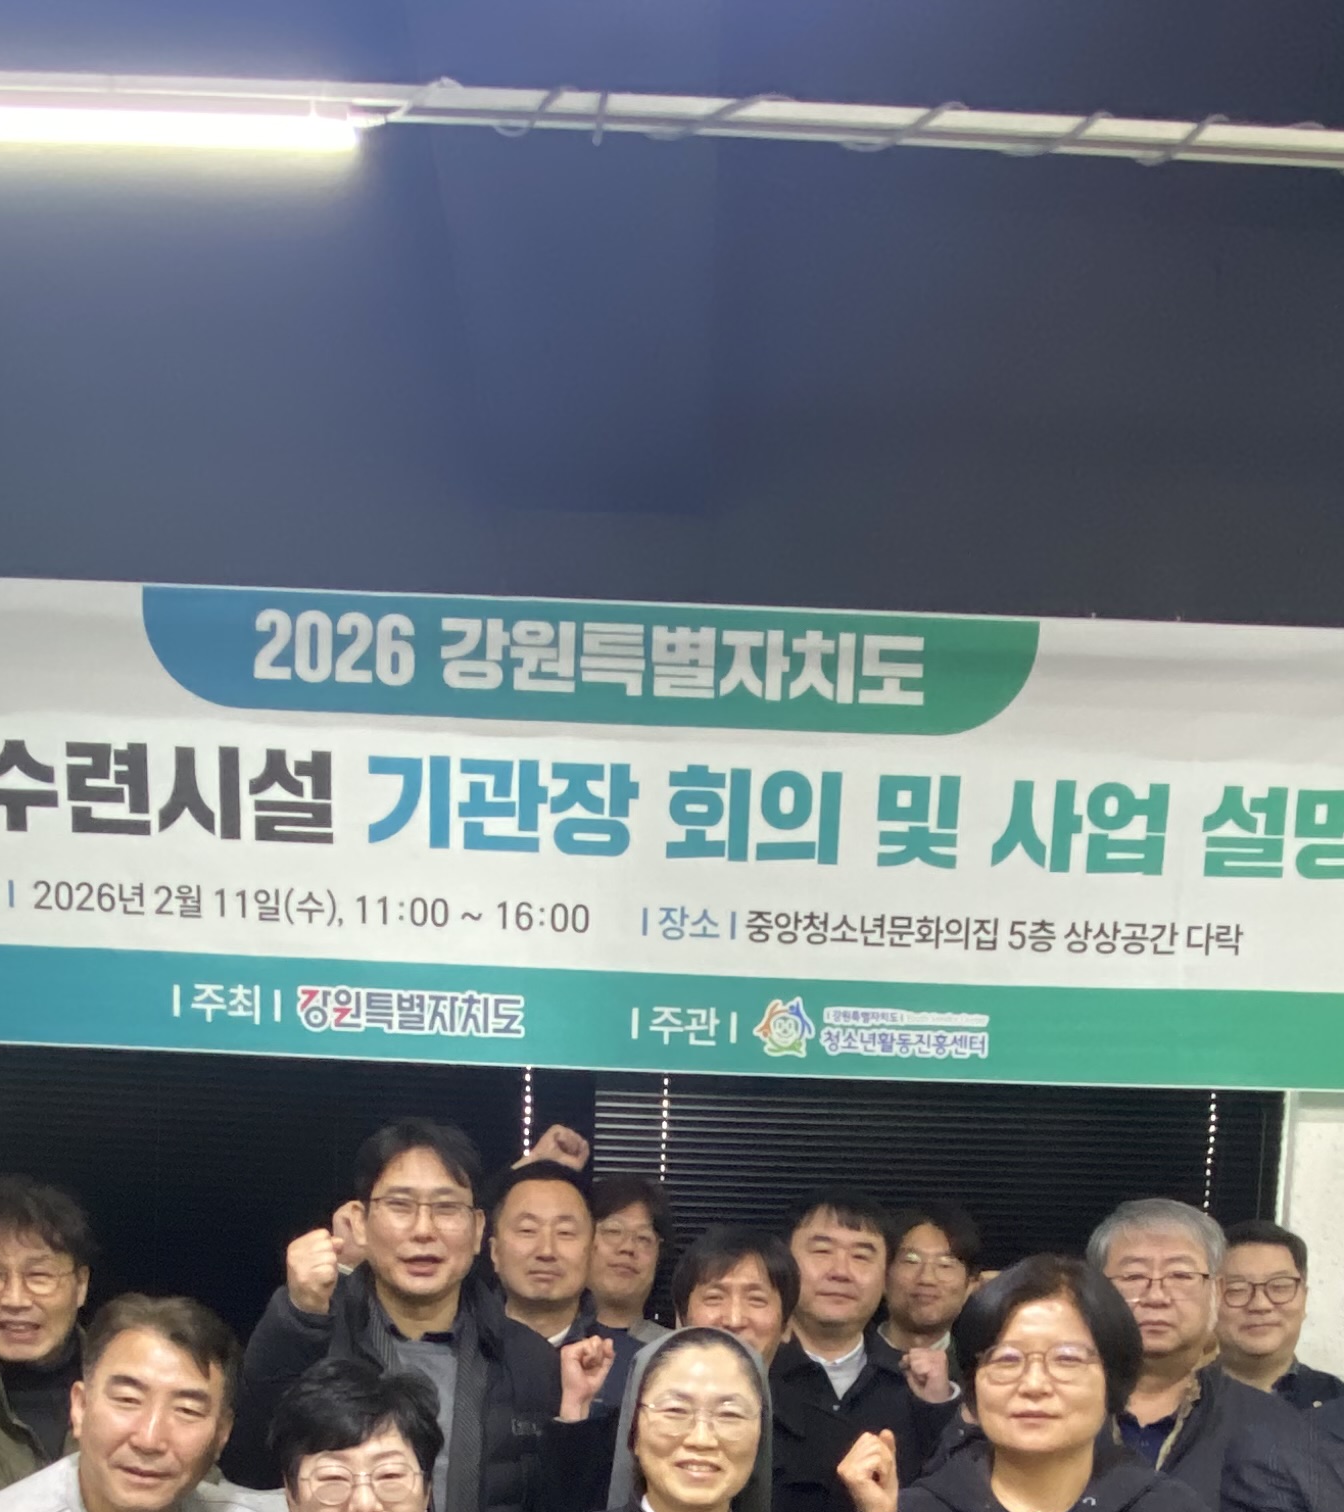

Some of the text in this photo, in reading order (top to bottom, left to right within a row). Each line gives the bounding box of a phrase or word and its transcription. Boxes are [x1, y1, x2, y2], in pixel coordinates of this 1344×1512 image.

[253, 607, 925, 706] 2026 강원특별자치도
[366, 753, 640, 858] 기관장
[665, 762, 843, 866] 회의
[875, 773, 962, 871] 및
[990, 778, 1171, 877] 사업
[32, 880, 145, 916] 2026년
[153, 884, 203, 919] 2월
[213, 887, 344, 927] 11일(수),
[355, 895, 450, 928] 11:00
[496, 900, 590, 934] 16:00
[745, 909, 1000, 951] 중앙청소년문화의집
[1007, 919, 1057, 953] 5층
[1063, 920, 1180, 956] 상상공간
[1186, 922, 1245, 957] 다락
[300, 987, 523, 1035] 강원특별자치도
[823, 1029, 986, 1057] 청소년활동진흥센터
